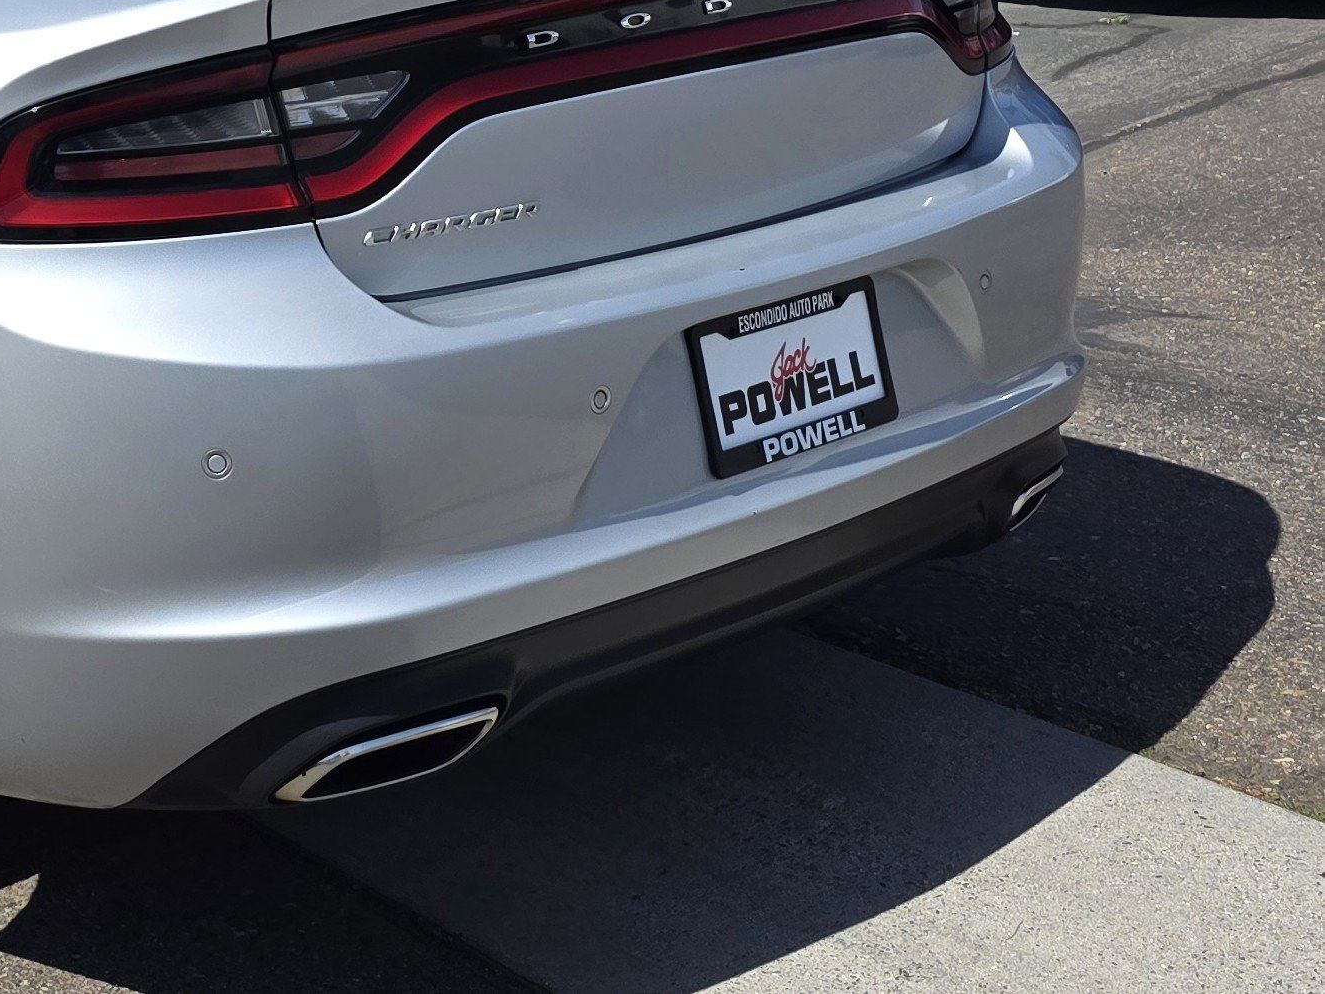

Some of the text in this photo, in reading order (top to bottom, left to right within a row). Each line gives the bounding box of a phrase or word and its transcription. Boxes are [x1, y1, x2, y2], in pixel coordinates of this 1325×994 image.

[362, 201, 541, 247] CHARGER
[737, 290, 835, 334] ESCONDIDO AUTO PARK
[718, 350, 876, 437] POWELL
[770, 337, 817, 402] Jack
[762, 410, 867, 463] POWELL
